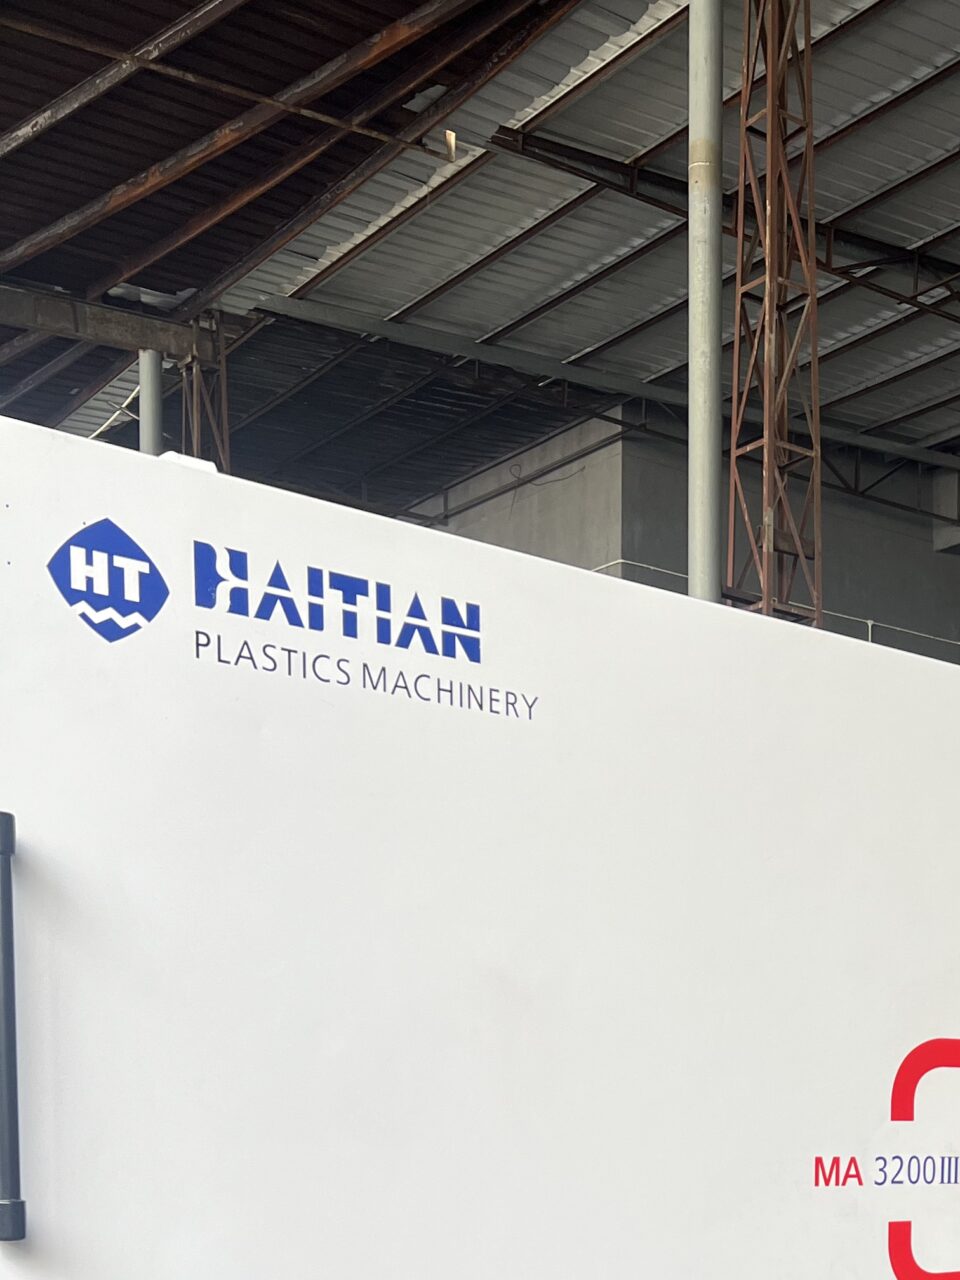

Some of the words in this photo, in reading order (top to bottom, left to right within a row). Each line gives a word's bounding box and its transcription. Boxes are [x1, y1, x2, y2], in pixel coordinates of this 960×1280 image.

[69, 544, 151, 603] HT
[193, 539, 482, 664] HAITIAN
[194, 630, 352, 686] PLASTICS
[362, 662, 539, 720] MACHINERY
[814, 1156, 864, 1187] MA
